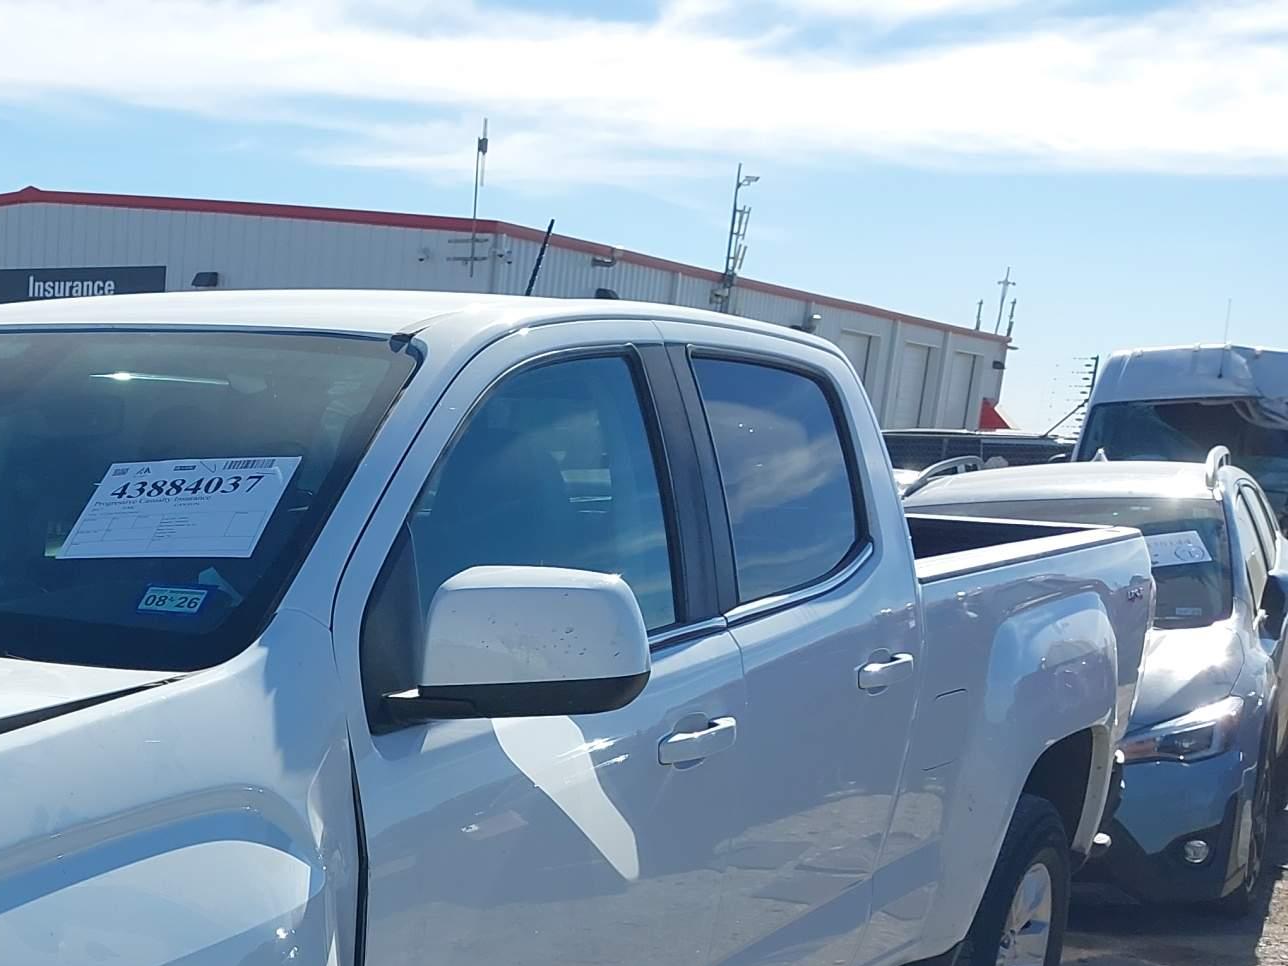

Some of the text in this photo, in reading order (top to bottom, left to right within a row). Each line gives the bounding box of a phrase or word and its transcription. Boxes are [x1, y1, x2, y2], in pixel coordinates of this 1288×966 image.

[28, 275, 115, 298] Insurance
[110, 475, 265, 500] 43884037
[144, 594, 201, 609] 08 26
